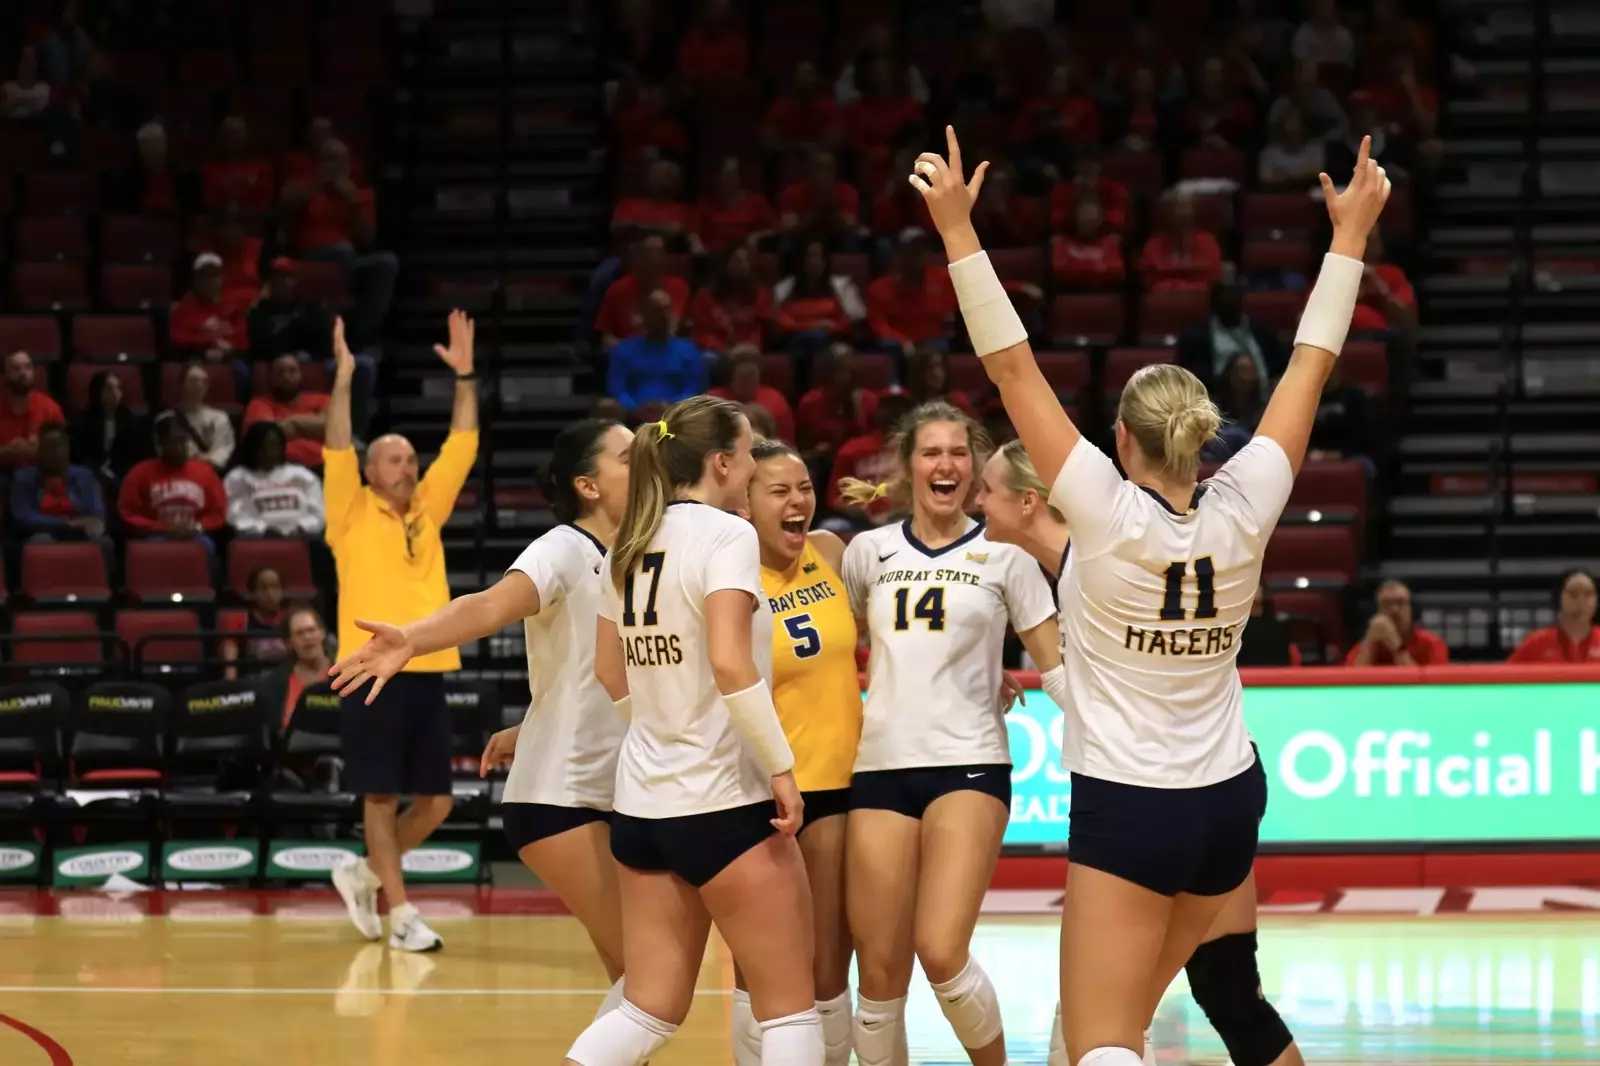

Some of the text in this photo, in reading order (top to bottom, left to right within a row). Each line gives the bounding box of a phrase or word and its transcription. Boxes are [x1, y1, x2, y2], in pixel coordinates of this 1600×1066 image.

[623, 550, 667, 627] 17
[798, 580, 836, 606] STATE
[877, 569, 980, 587] MURRAY STATE
[1160, 555, 1218, 620] 11
[894, 586, 946, 632] 14
[620, 633, 683, 666] ACERS
[782, 611, 823, 659] 5
[1280, 728, 1551, 798] Official
